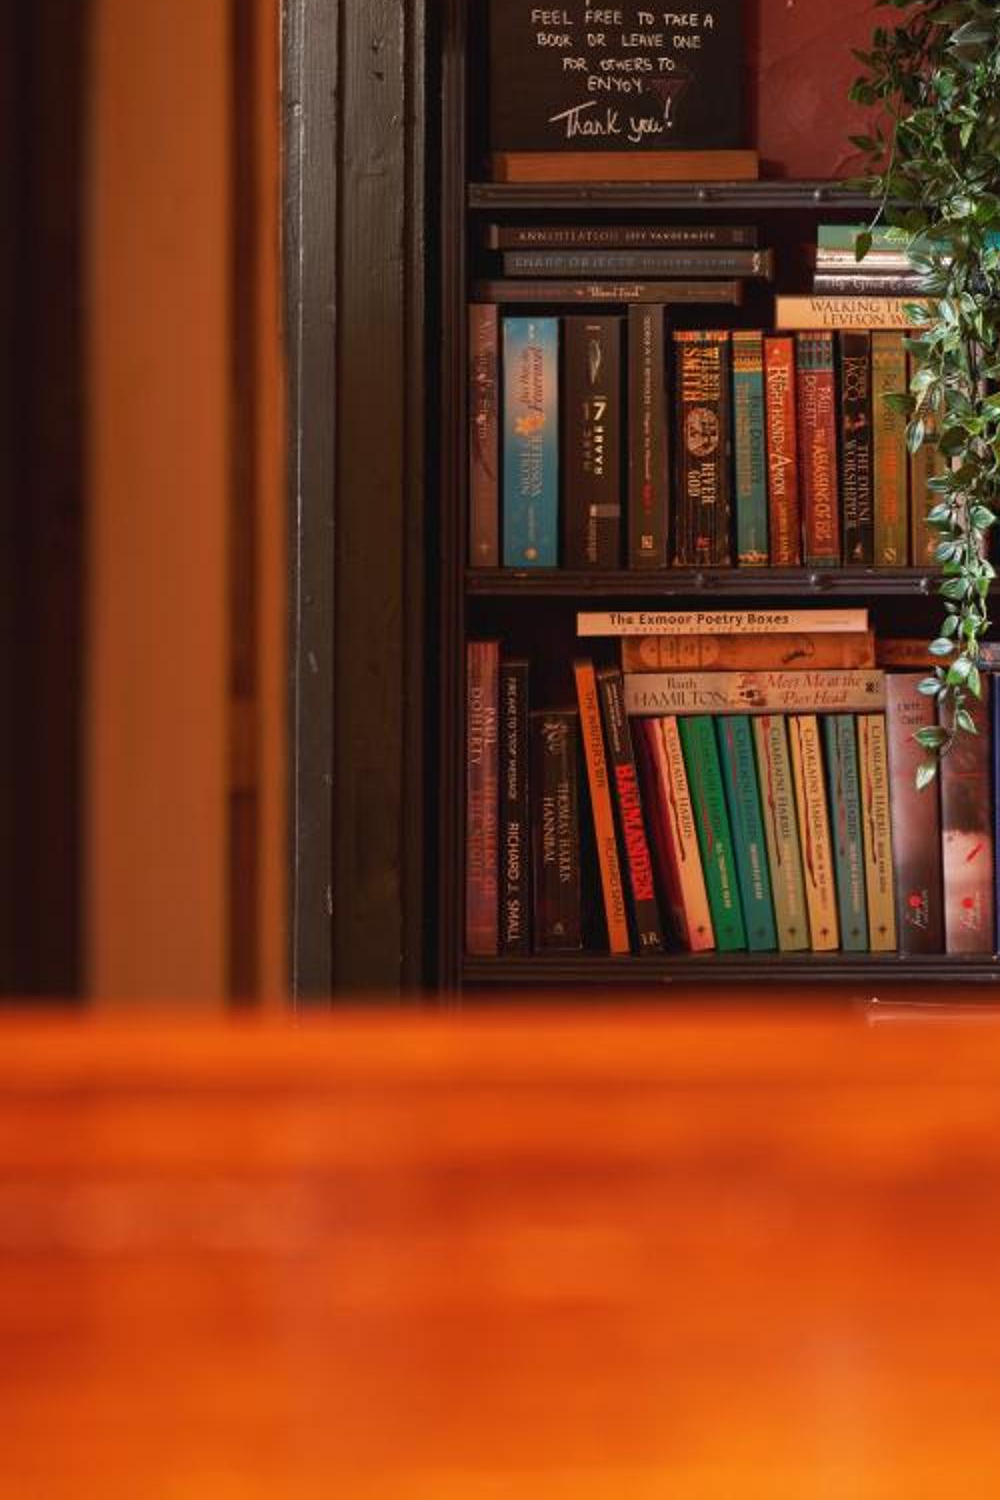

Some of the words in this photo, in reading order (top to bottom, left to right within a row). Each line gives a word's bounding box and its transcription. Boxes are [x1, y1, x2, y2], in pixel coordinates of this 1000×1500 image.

[531, 9, 573, 25] FEEL
[585, 10, 622, 25] FREE
[638, 12, 656, 27] TO
[663, 12, 700, 27] TAKE
[703, 13, 714, 28] A
[537, 34, 572, 48] BOOK
[587, 34, 606, 48] OR
[622, 34, 663, 49] LEAVE
[673, 35, 701, 49] ONE
[563, 57, 587, 72] FOR
[600, 57, 653, 72] OTHERS
[657, 57, 675, 72] TO
[549, 101, 620, 138] Thank
[812, 300, 880, 312] WALKING
[823, 314, 884, 325] LEVISON
[682, 347, 702, 401] SMITH
[804, 374, 819, 427] DOHERTY
[687, 470, 700, 498] GOD
[701, 462, 717, 504] RIVER
[609, 614, 633, 624] The
[640, 614, 692, 624] Exmoor
[698, 614, 742, 627] Poetry
[747, 614, 789, 624] Boxes
[804, 674, 827, 687] Me
[829, 675, 841, 687] at
[843, 674, 862, 687] the
[634, 691, 728, 707] HAMILTON
[814, 691, 847, 705] Head
[803, 726, 818, 796] CHARLAINE
[871, 724, 885, 789] CHARLAINE
[555, 781, 570, 838] THOMAS
[542, 797, 556, 864] HANNIBAL
[506, 822, 520, 880] RICHARD
[506, 898, 520, 942] SMALL
